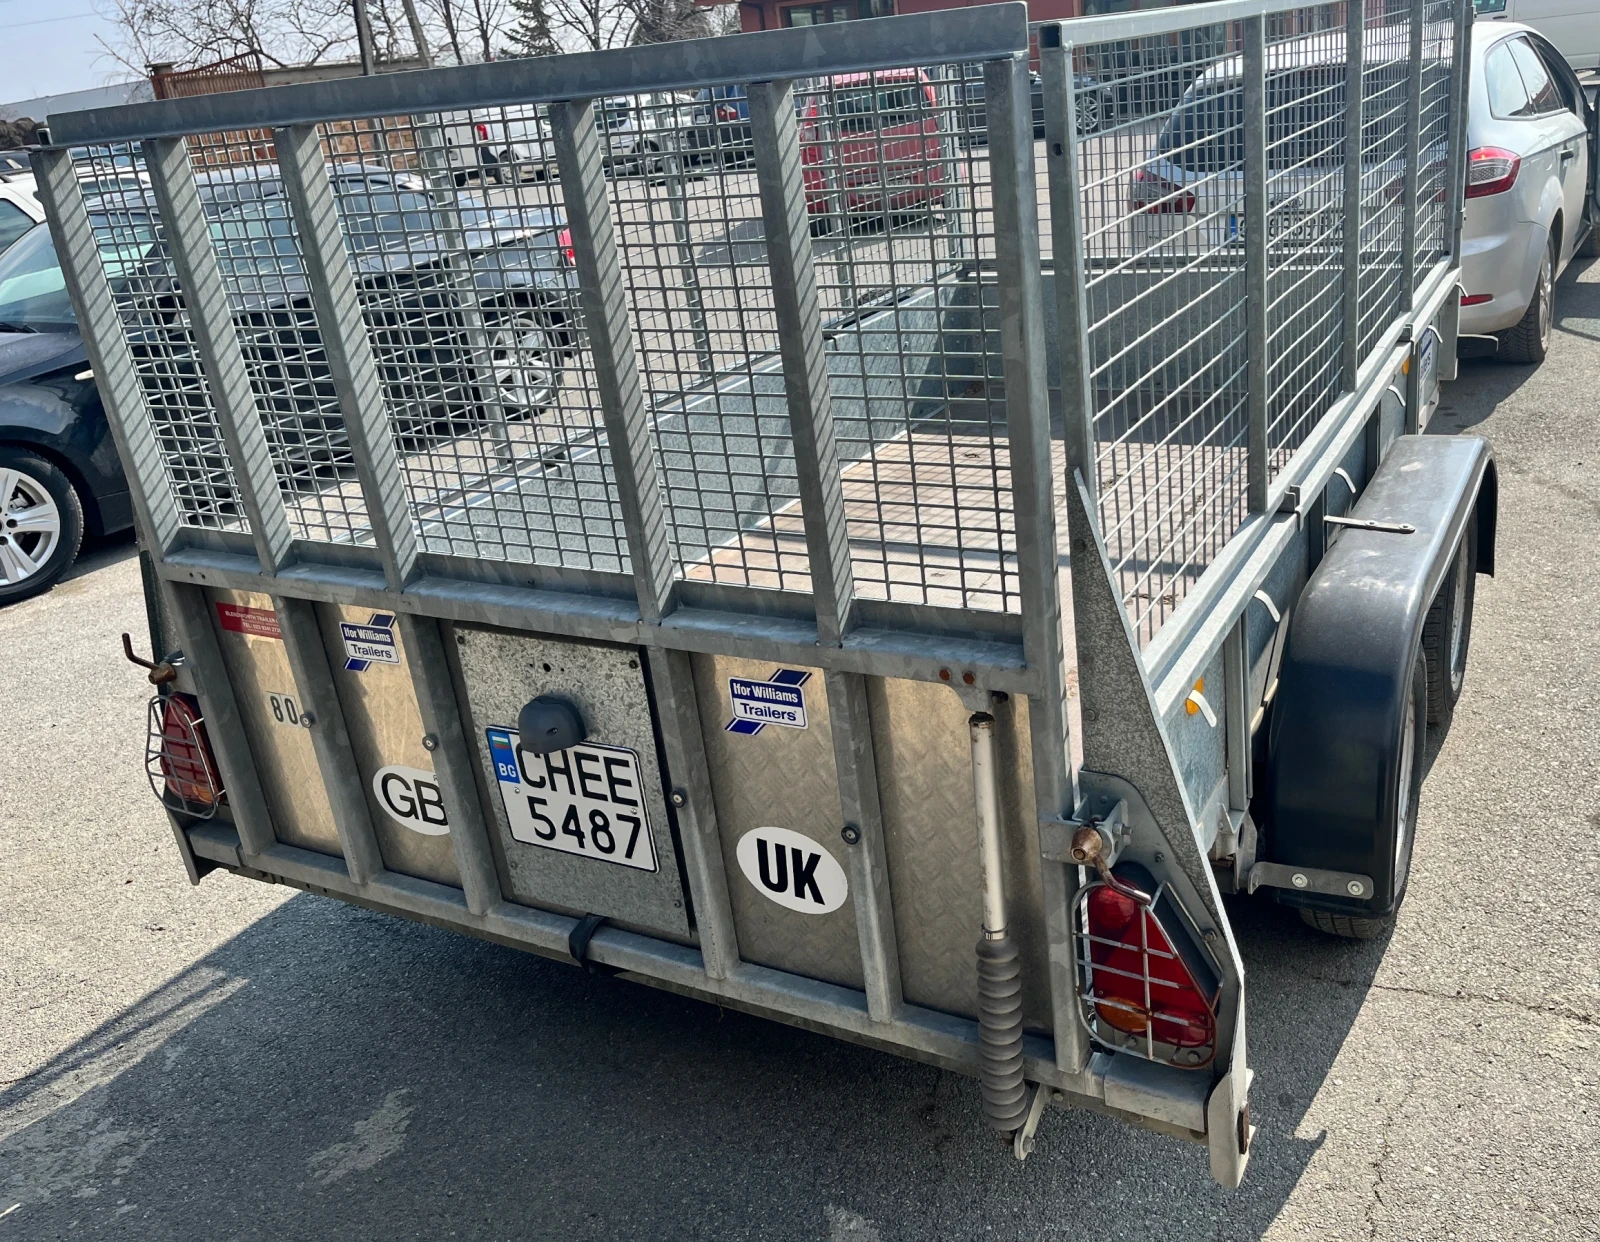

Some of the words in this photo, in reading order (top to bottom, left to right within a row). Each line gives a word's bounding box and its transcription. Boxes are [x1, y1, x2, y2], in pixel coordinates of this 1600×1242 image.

[256, 615, 276, 623] TRAILER
[343, 626, 357, 638] Ifor
[357, 628, 391, 643] Williams
[351, 643, 392, 658] Trailers
[732, 682, 751, 696] Ifor
[751, 685, 799, 703] Williams
[270, 695, 298, 725] 80
[740, 702, 797, 721] Trailers
[498, 762, 517, 778] BG
[381, 772, 449, 827] GB
[526, 795, 642, 860] 5487
[756, 837, 826, 906] UK
